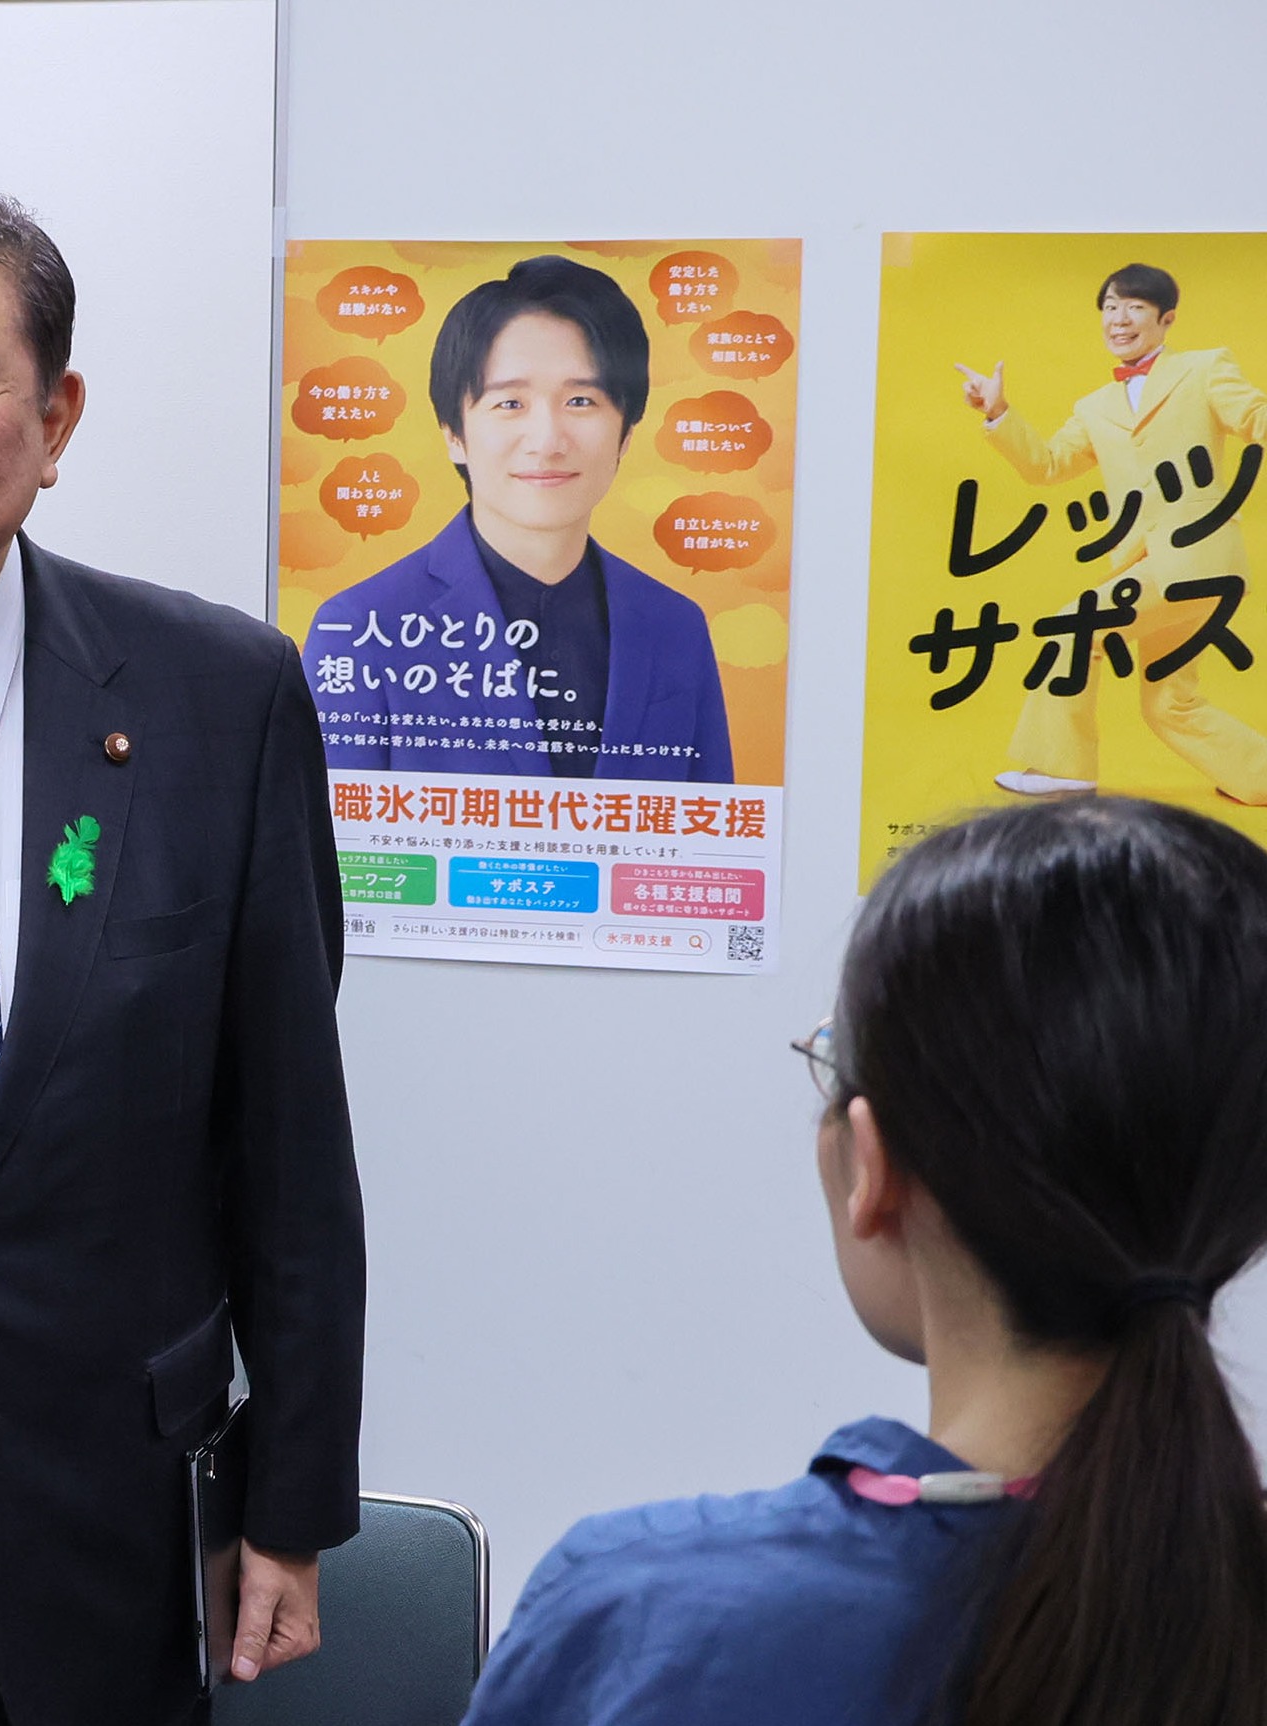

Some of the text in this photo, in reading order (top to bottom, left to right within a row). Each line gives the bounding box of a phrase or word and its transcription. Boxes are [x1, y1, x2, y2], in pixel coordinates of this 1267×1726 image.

[669, 265, 720, 278] 安定した
[348, 283, 399, 296] スキルや
[668, 283, 719, 296] 働き方を
[337, 302, 407, 316] 経験がない
[675, 301, 713, 314] したい
[308, 385, 391, 400] 今の働き方を
[322, 405, 377, 421] 変えたい
[682, 439, 746, 452] 相談したい
[357, 470, 381, 484] 人と
[336, 486, 403, 501] 関わるのが
[355, 504, 383, 518] 苦手
[948, 442, 1265, 578] レッツ
[673, 517, 761, 531] 自立したいけど
[683, 536, 750, 550] 自信がない
[316, 609, 540, 650] 一人ひとりの
[316, 654, 578, 704] 想いのそばに。
[333, 782, 766, 840] 職氷河期世代活躍支援
[489, 878, 556, 895] サポステ
[633, 883, 743, 905] 各種支援機関
[606, 932, 674, 948] 氷河期支援
